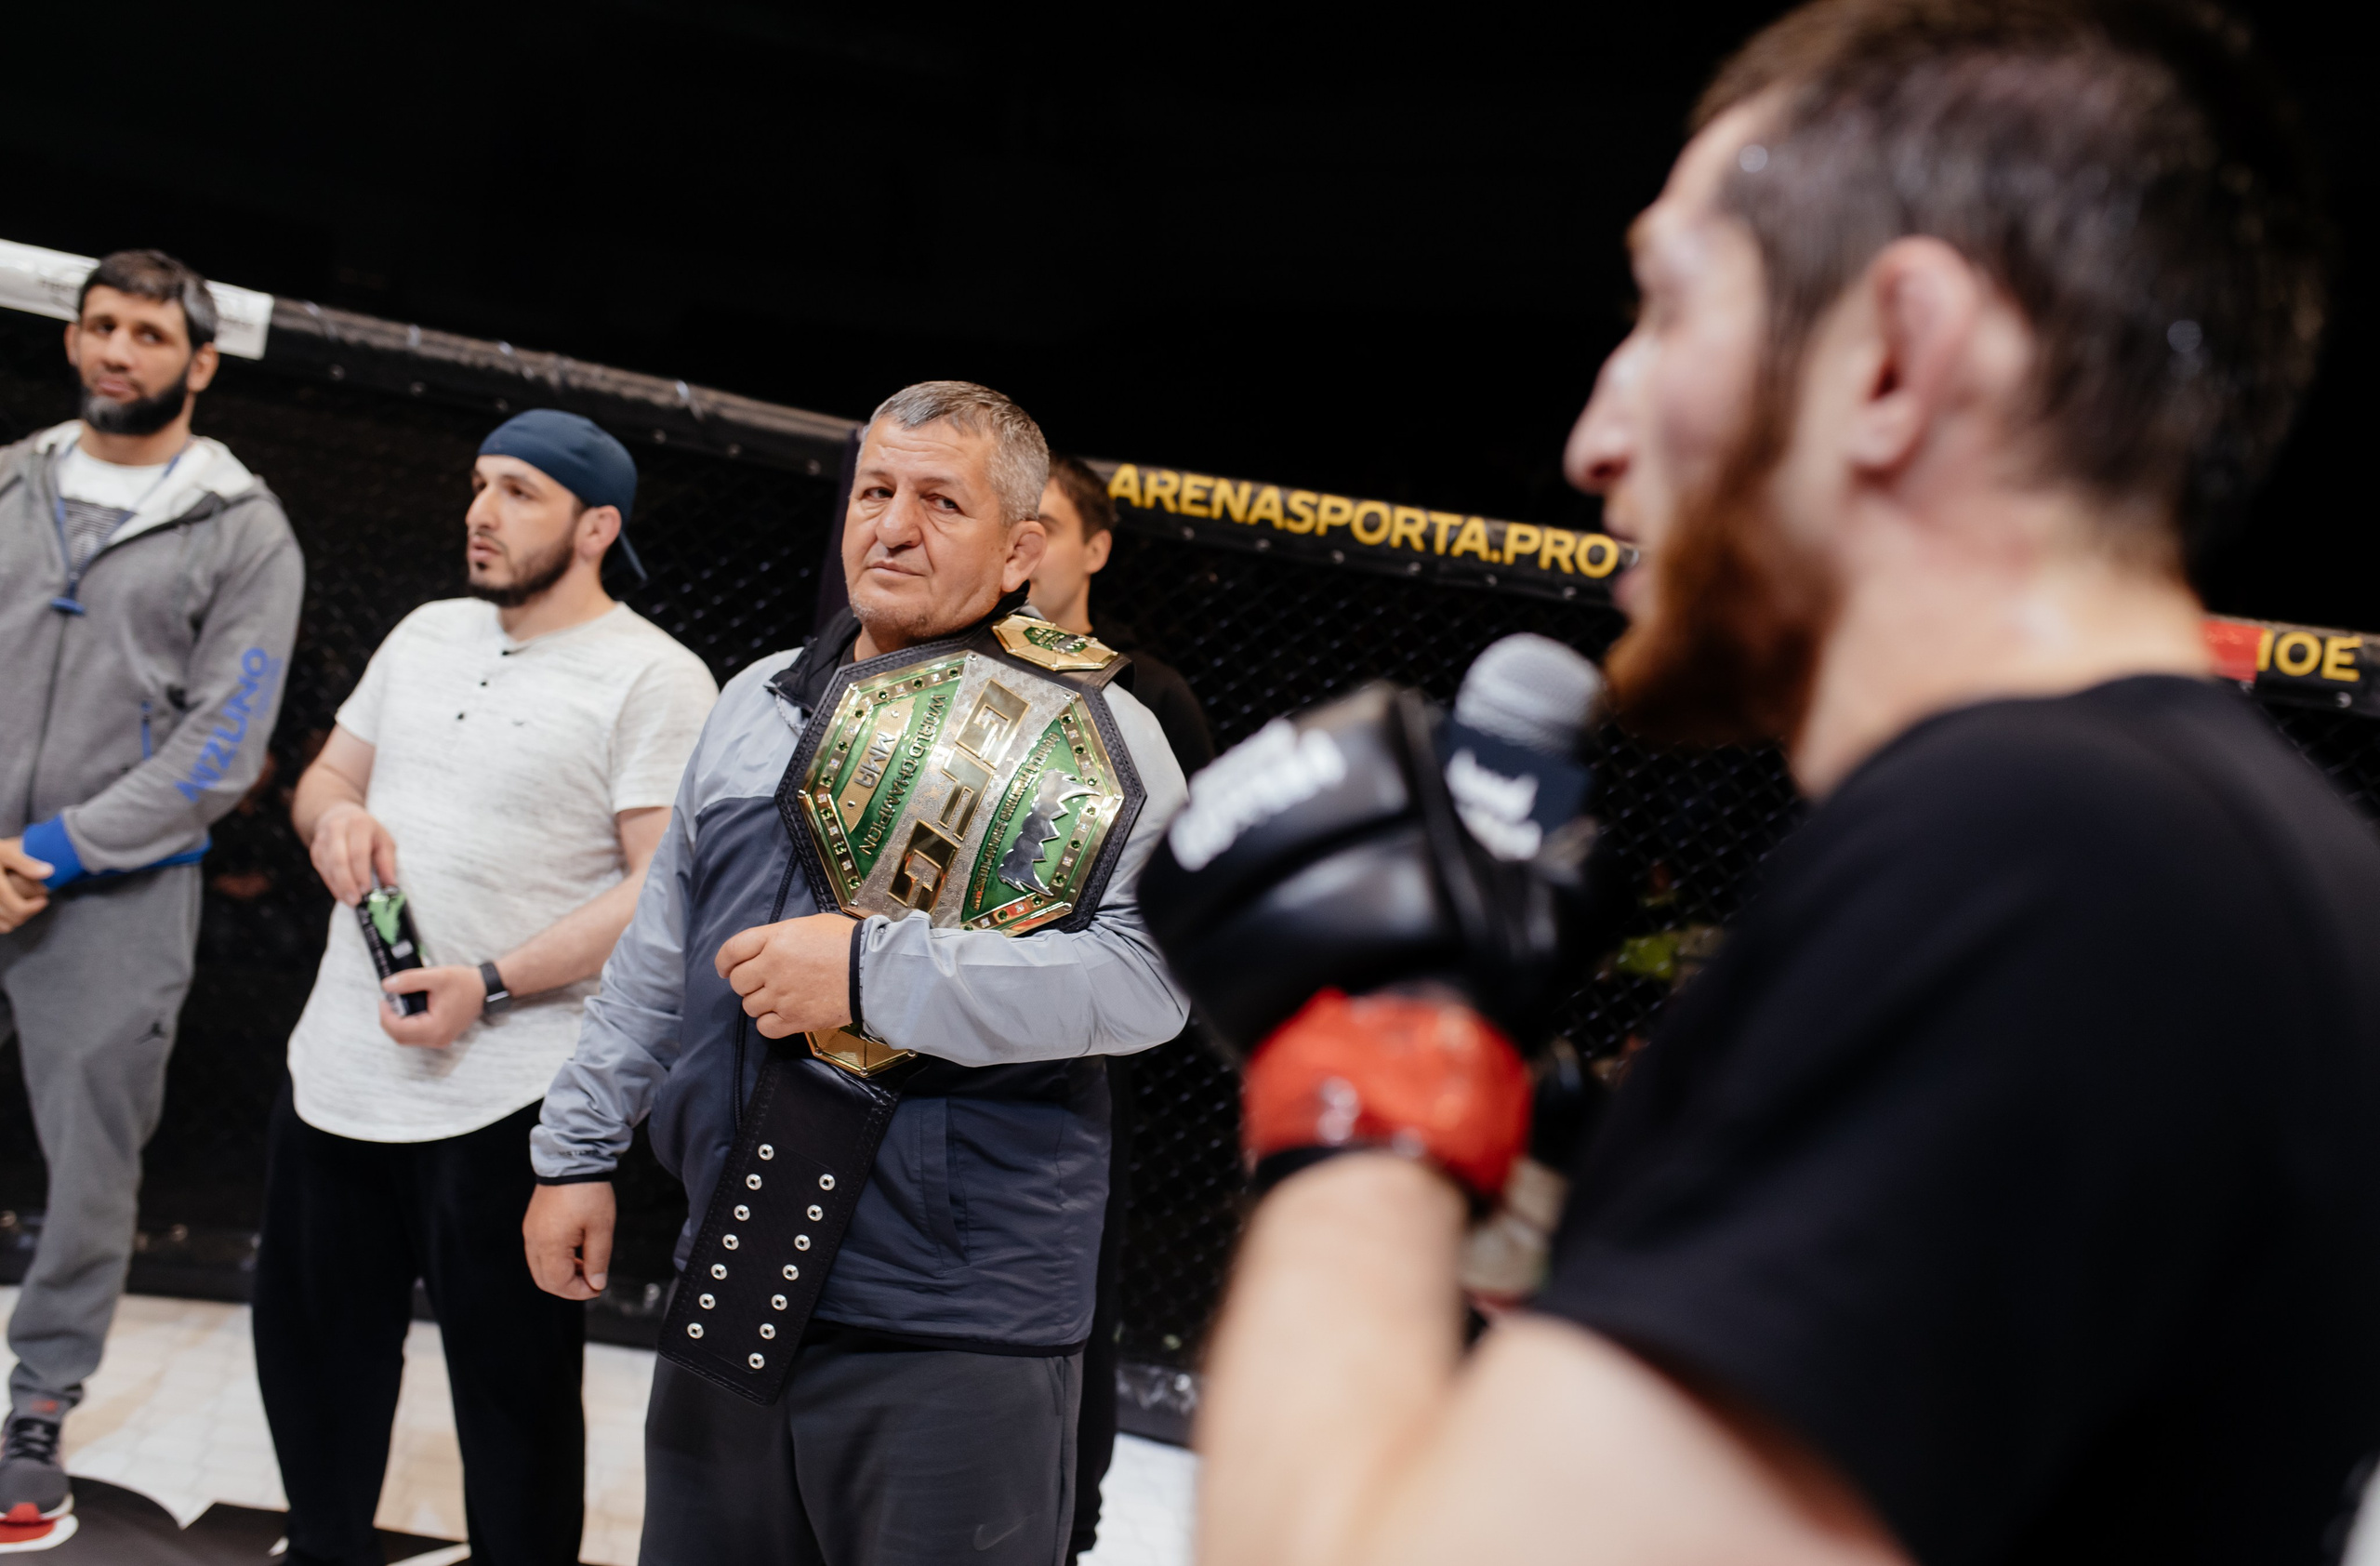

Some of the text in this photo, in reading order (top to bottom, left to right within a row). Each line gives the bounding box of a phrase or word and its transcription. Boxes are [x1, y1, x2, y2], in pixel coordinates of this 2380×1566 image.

[1108, 464, 1620, 578] ARENASPORTA.PRO
[853, 731, 896, 790] MMA
[858, 694, 949, 856] WORLD CHAMPION
[888, 679, 1029, 915] GFC
